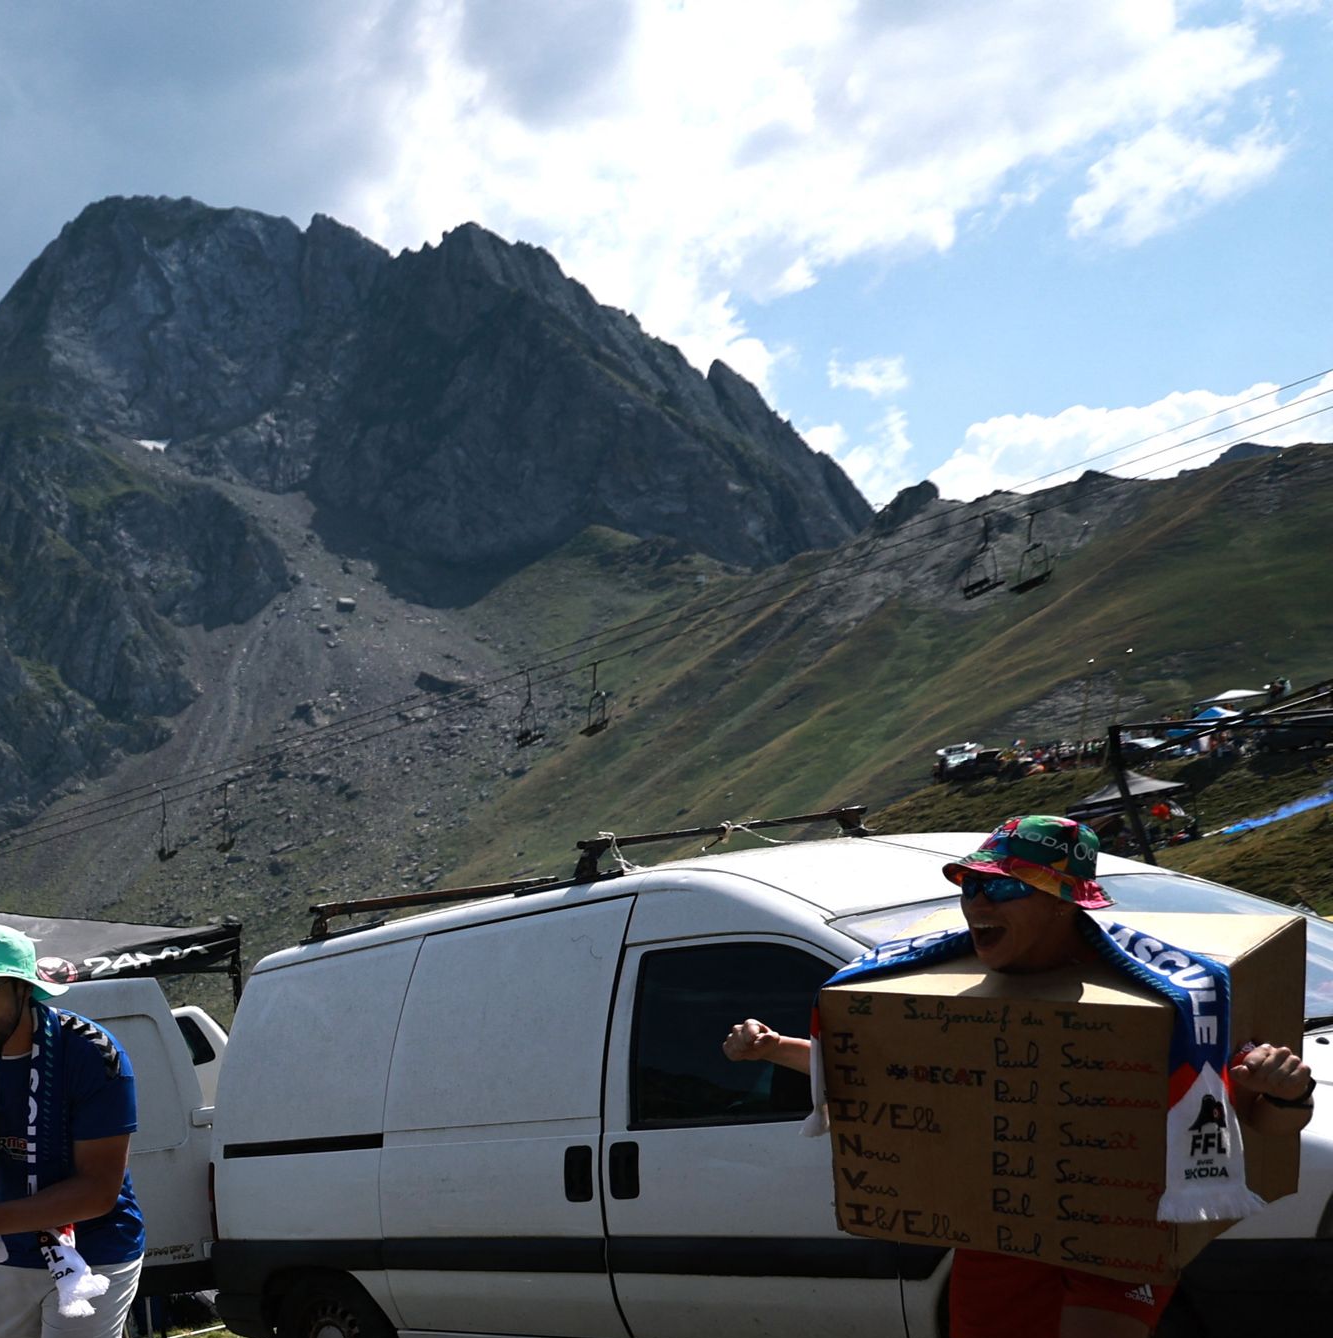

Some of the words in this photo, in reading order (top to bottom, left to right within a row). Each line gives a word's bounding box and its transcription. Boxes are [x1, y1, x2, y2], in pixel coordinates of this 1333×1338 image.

[1021, 1012, 1045, 1026] du
[1055, 1010, 1114, 1033] Tour
[833, 1032, 860, 1055] Je
[993, 1037, 1039, 1069] Paul
[835, 1063, 868, 1087] Tu
[994, 1080, 1039, 1105] Paul
[993, 1115, 1037, 1144] Paul
[1190, 1132, 1227, 1156] FFL
[838, 1133, 902, 1164] Nous
[992, 1151, 1037, 1180] Paul
[841, 1166, 899, 1198] Vous
[992, 1187, 1035, 1218] Paul
[144, 1243, 195, 1258] UMPY
[996, 1225, 1042, 1257] Paul
